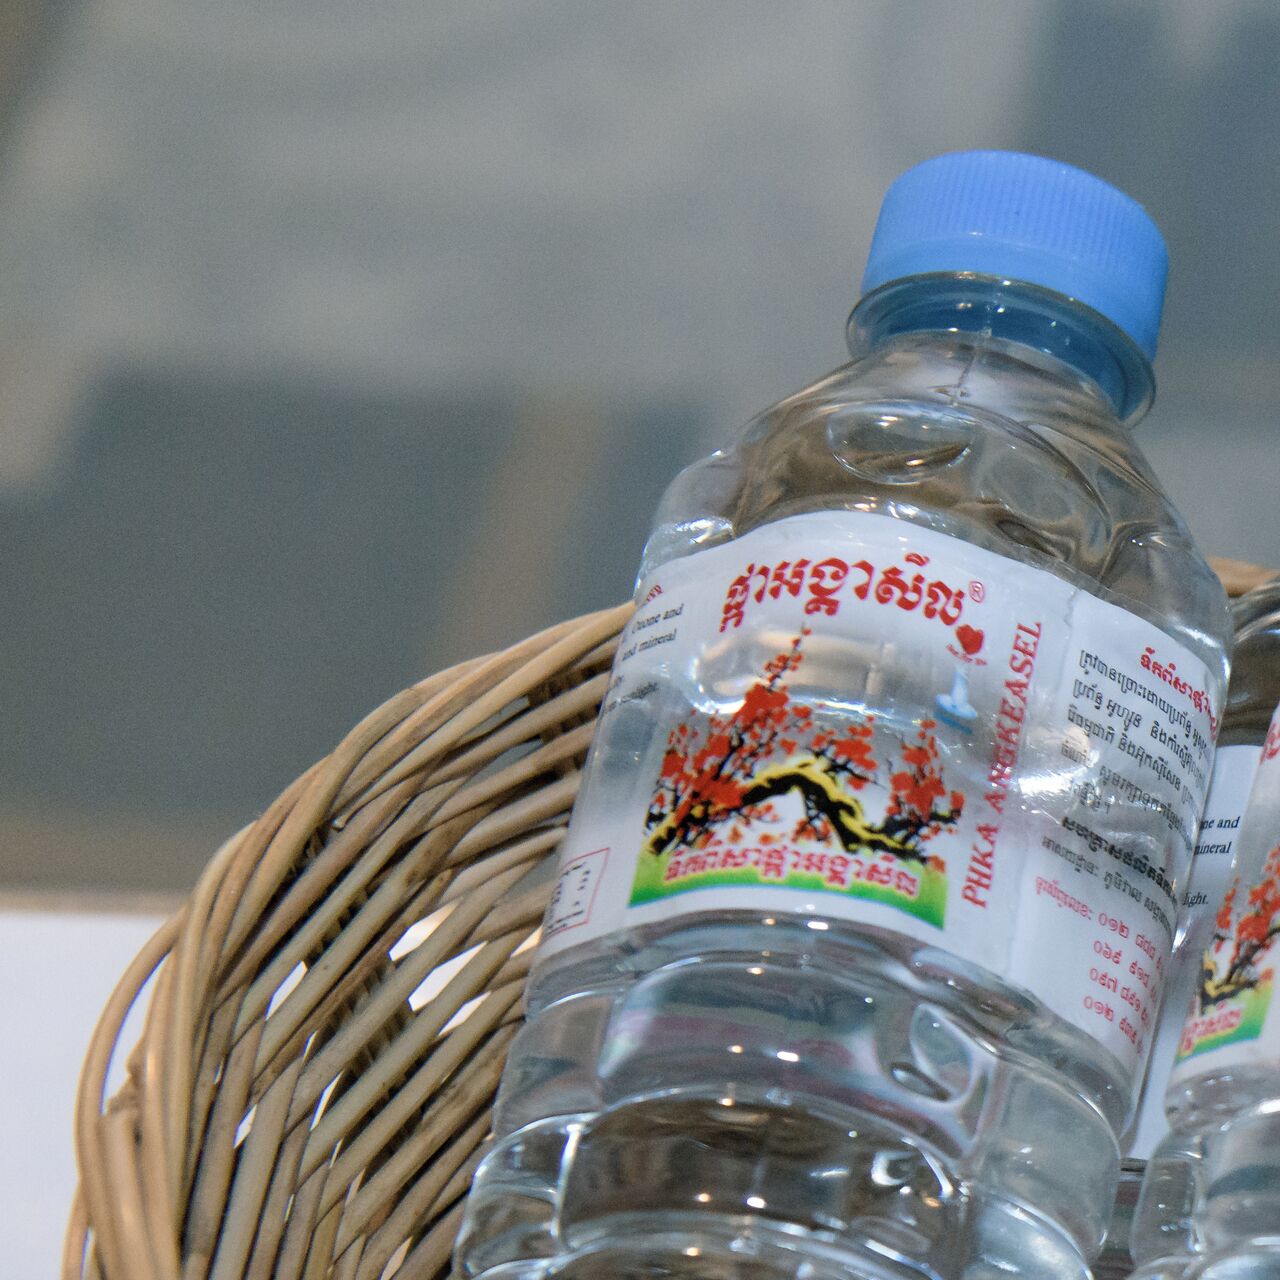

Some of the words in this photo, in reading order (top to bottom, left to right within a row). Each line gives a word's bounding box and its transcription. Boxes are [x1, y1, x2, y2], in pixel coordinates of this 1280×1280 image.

[639, 628, 678, 651] mineral
[1217, 816, 1240, 829] and
[961, 823, 998, 909] PHKA
